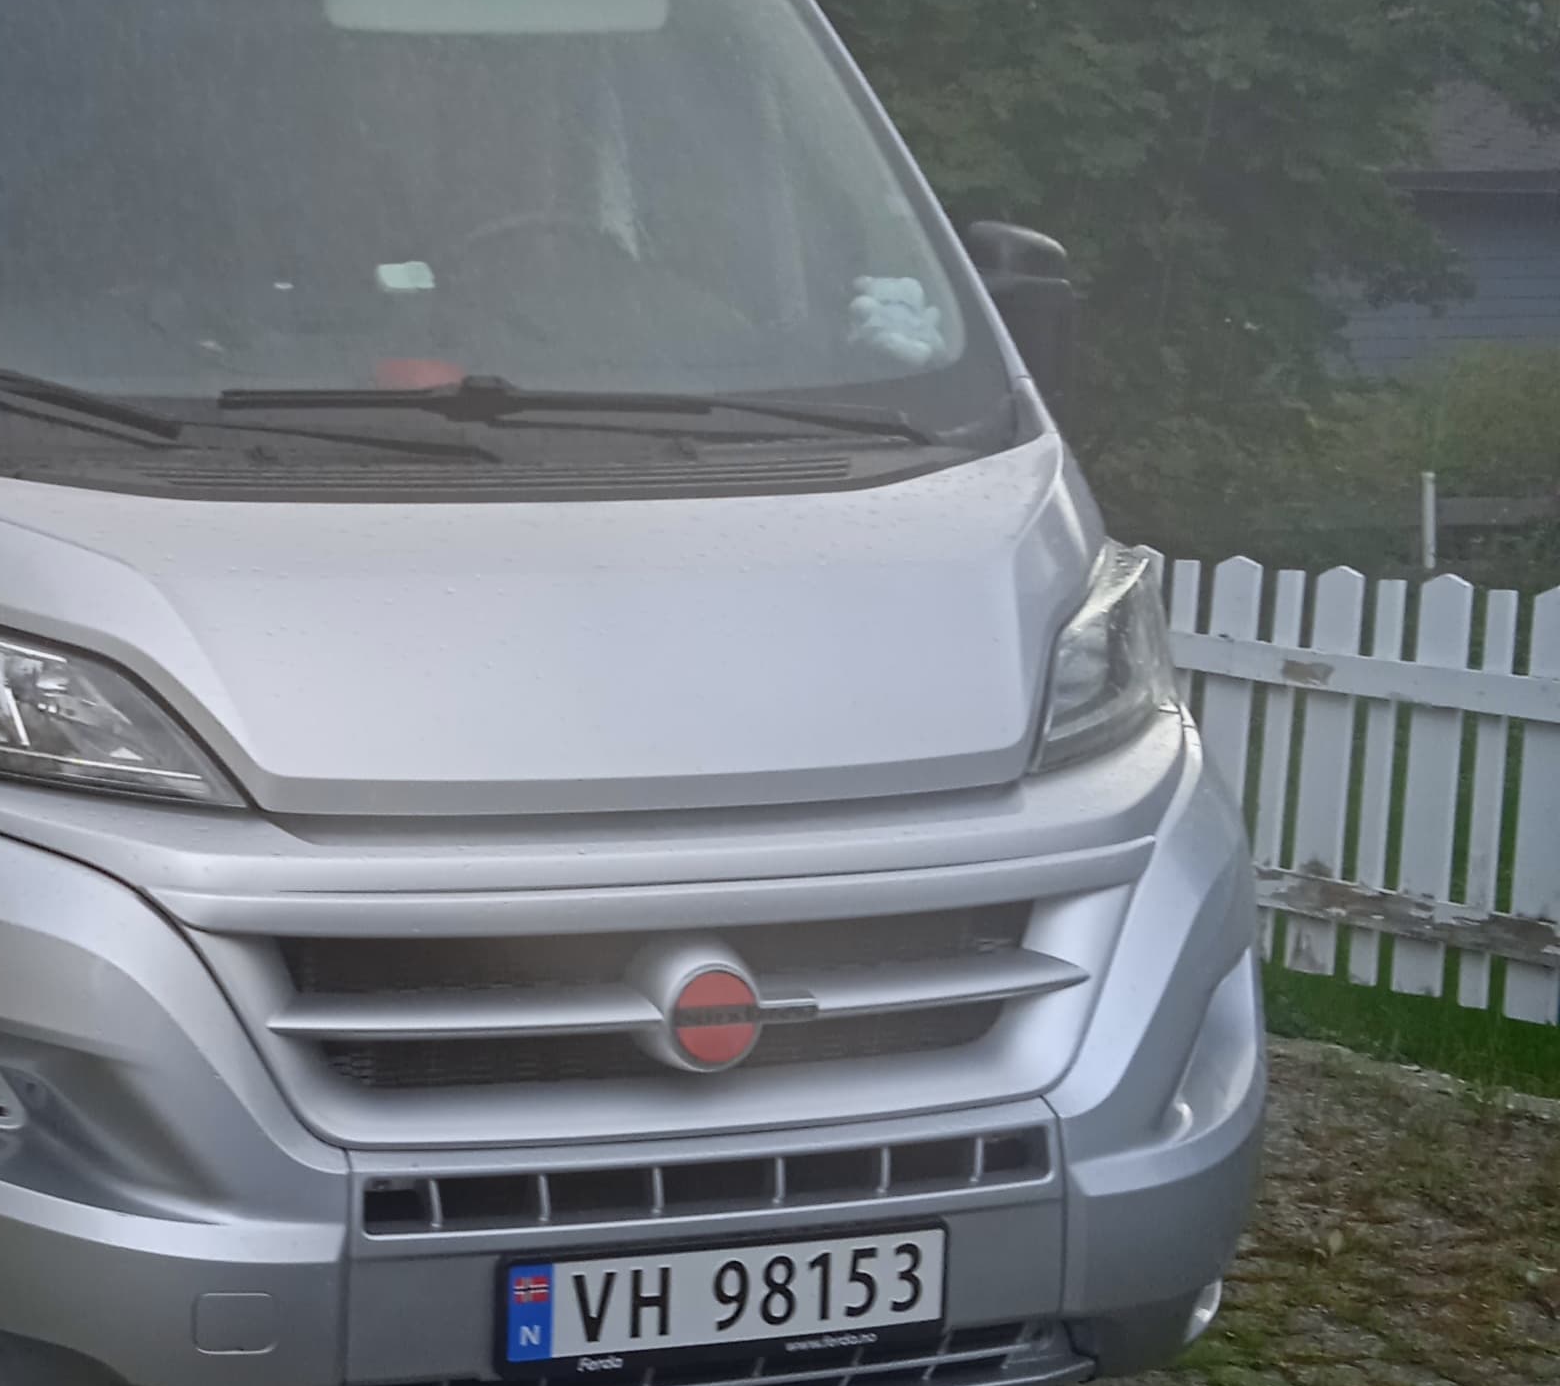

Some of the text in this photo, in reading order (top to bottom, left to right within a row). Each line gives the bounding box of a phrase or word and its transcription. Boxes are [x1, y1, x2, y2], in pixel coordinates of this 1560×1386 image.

[571, 1242, 923, 1343] VH 98153
[519, 1324, 541, 1347] N
